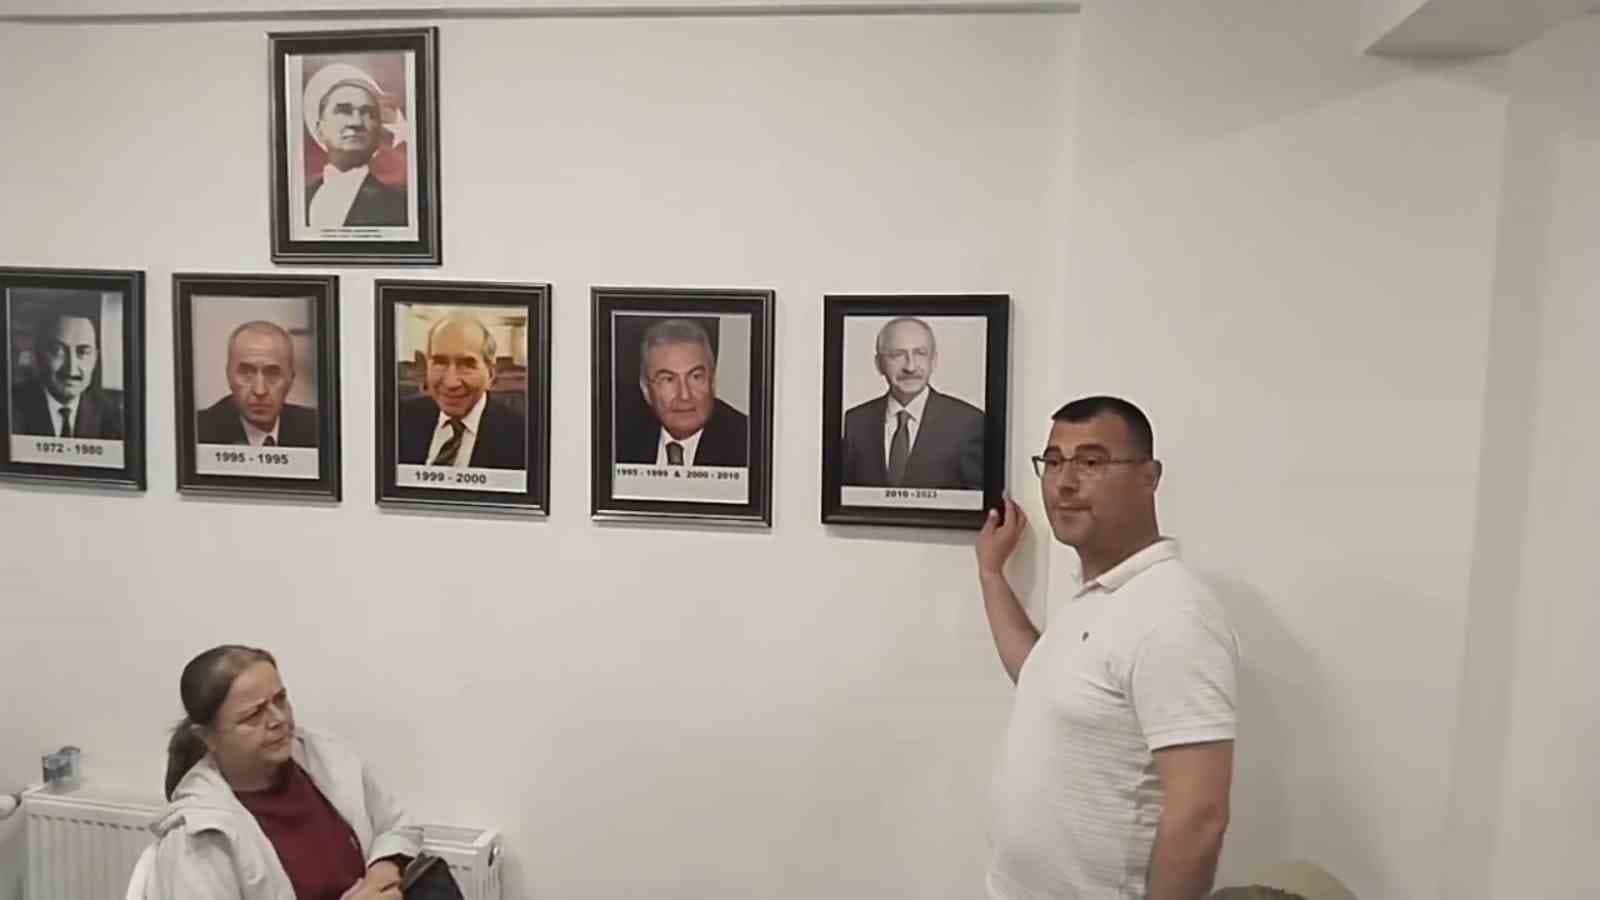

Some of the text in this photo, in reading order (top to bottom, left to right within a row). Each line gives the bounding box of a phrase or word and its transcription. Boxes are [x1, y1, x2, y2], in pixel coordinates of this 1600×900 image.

[215, 452, 245, 463] 1995
[258, 453, 289, 465] 1995
[456, 473, 487, 484] 2000
